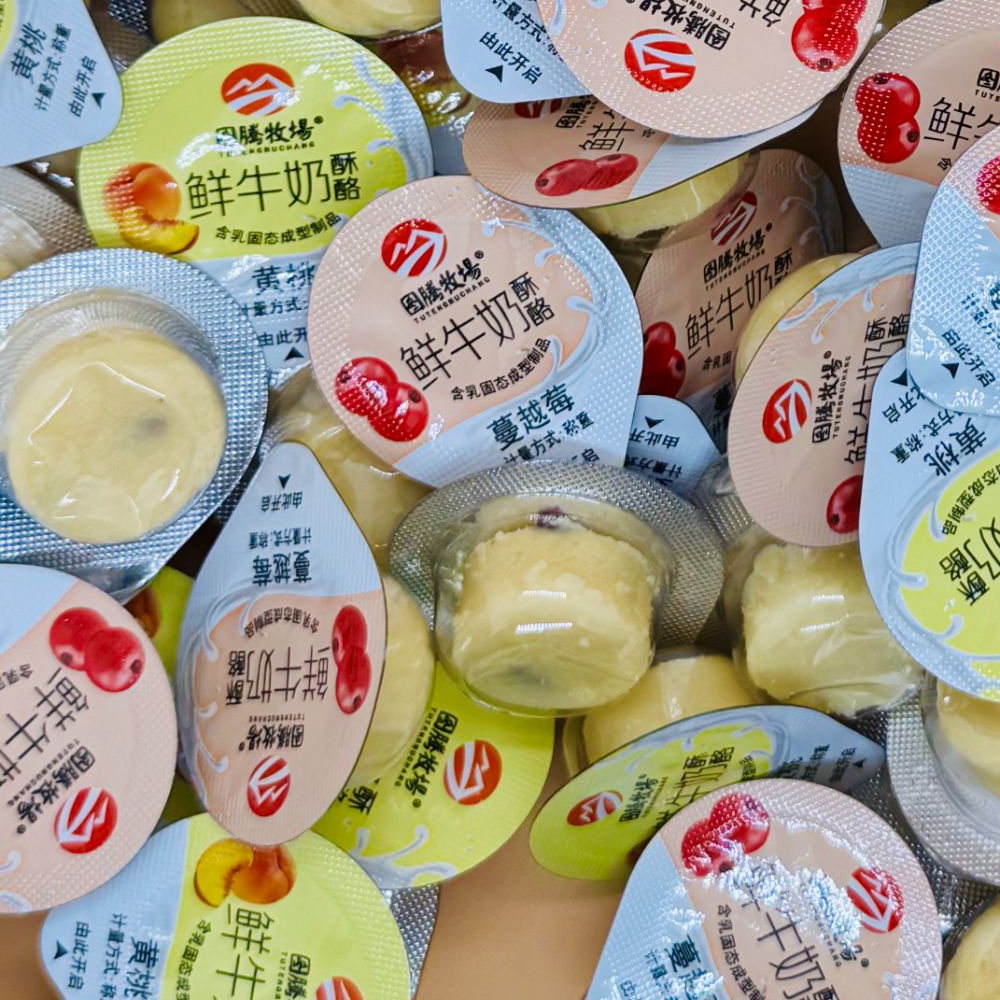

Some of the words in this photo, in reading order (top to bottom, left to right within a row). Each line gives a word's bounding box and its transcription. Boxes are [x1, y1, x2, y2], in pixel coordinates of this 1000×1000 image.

[6, 19, 49, 85] 黄桃
[479, 30, 544, 86] 由此开启
[68, 54, 98, 118] 由此开启
[484, 382, 579, 449] 蔓越莓
[919, 415, 991, 480] 黄桃
[64, 920, 88, 991] 由此开启
